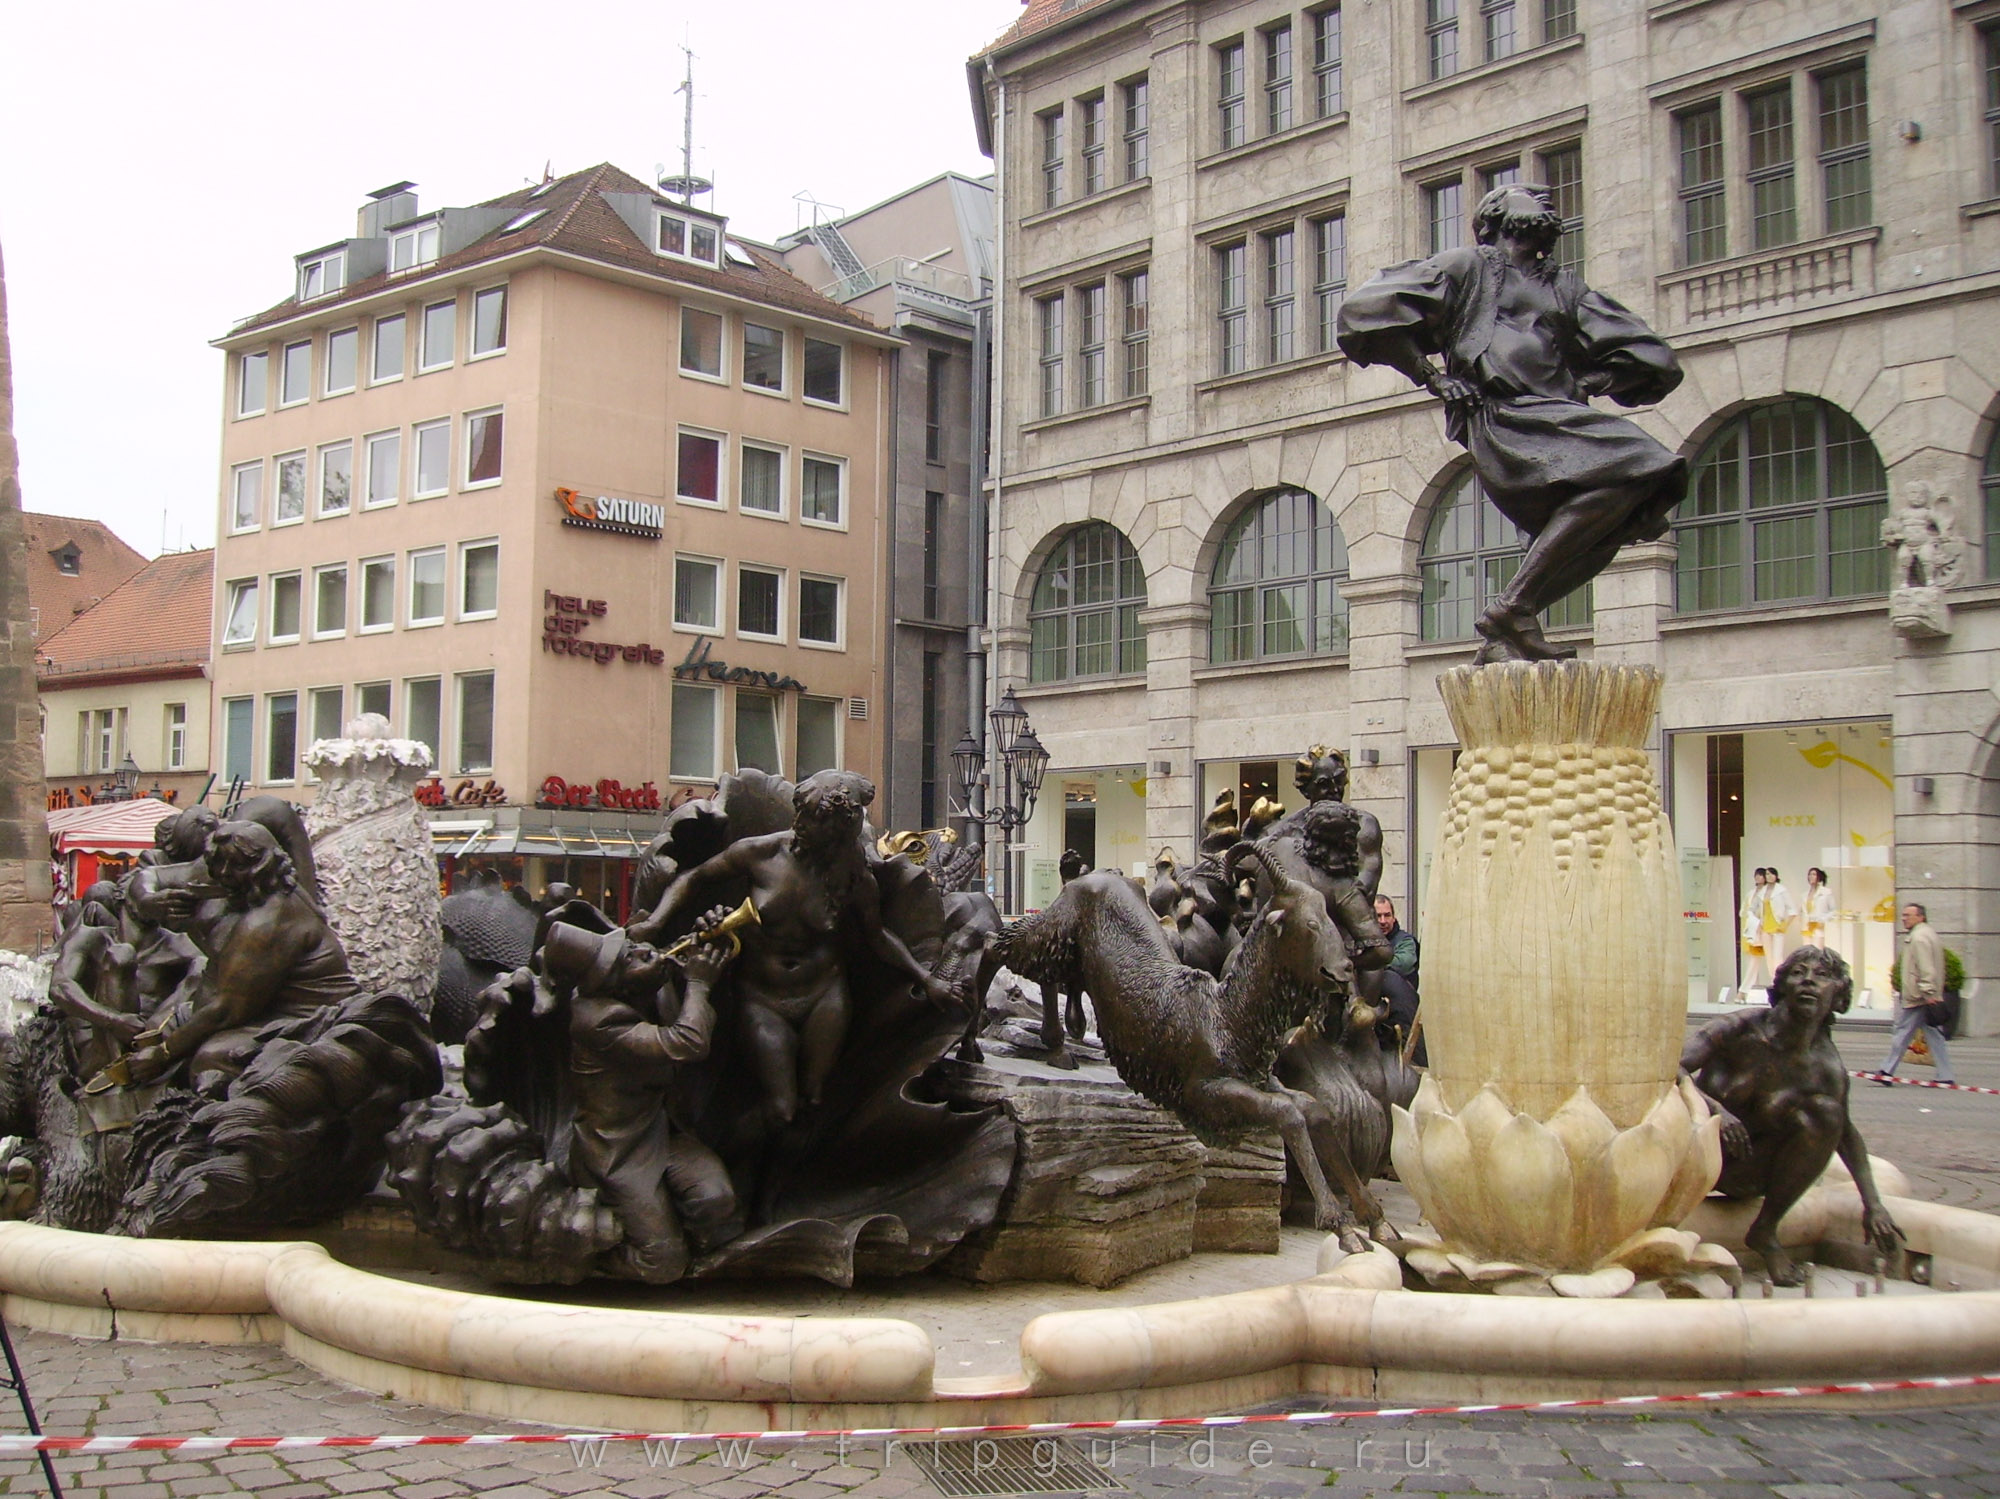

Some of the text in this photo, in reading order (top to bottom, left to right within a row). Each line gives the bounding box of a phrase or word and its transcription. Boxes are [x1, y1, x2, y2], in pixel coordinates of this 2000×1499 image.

[597, 496, 664, 529] SATURN
[544, 589, 608, 616] haus
[543, 613, 590, 634] der
[542, 632, 665, 665] fotografie
[542, 776, 592, 806] Der
[596, 779, 661, 811] Beck
